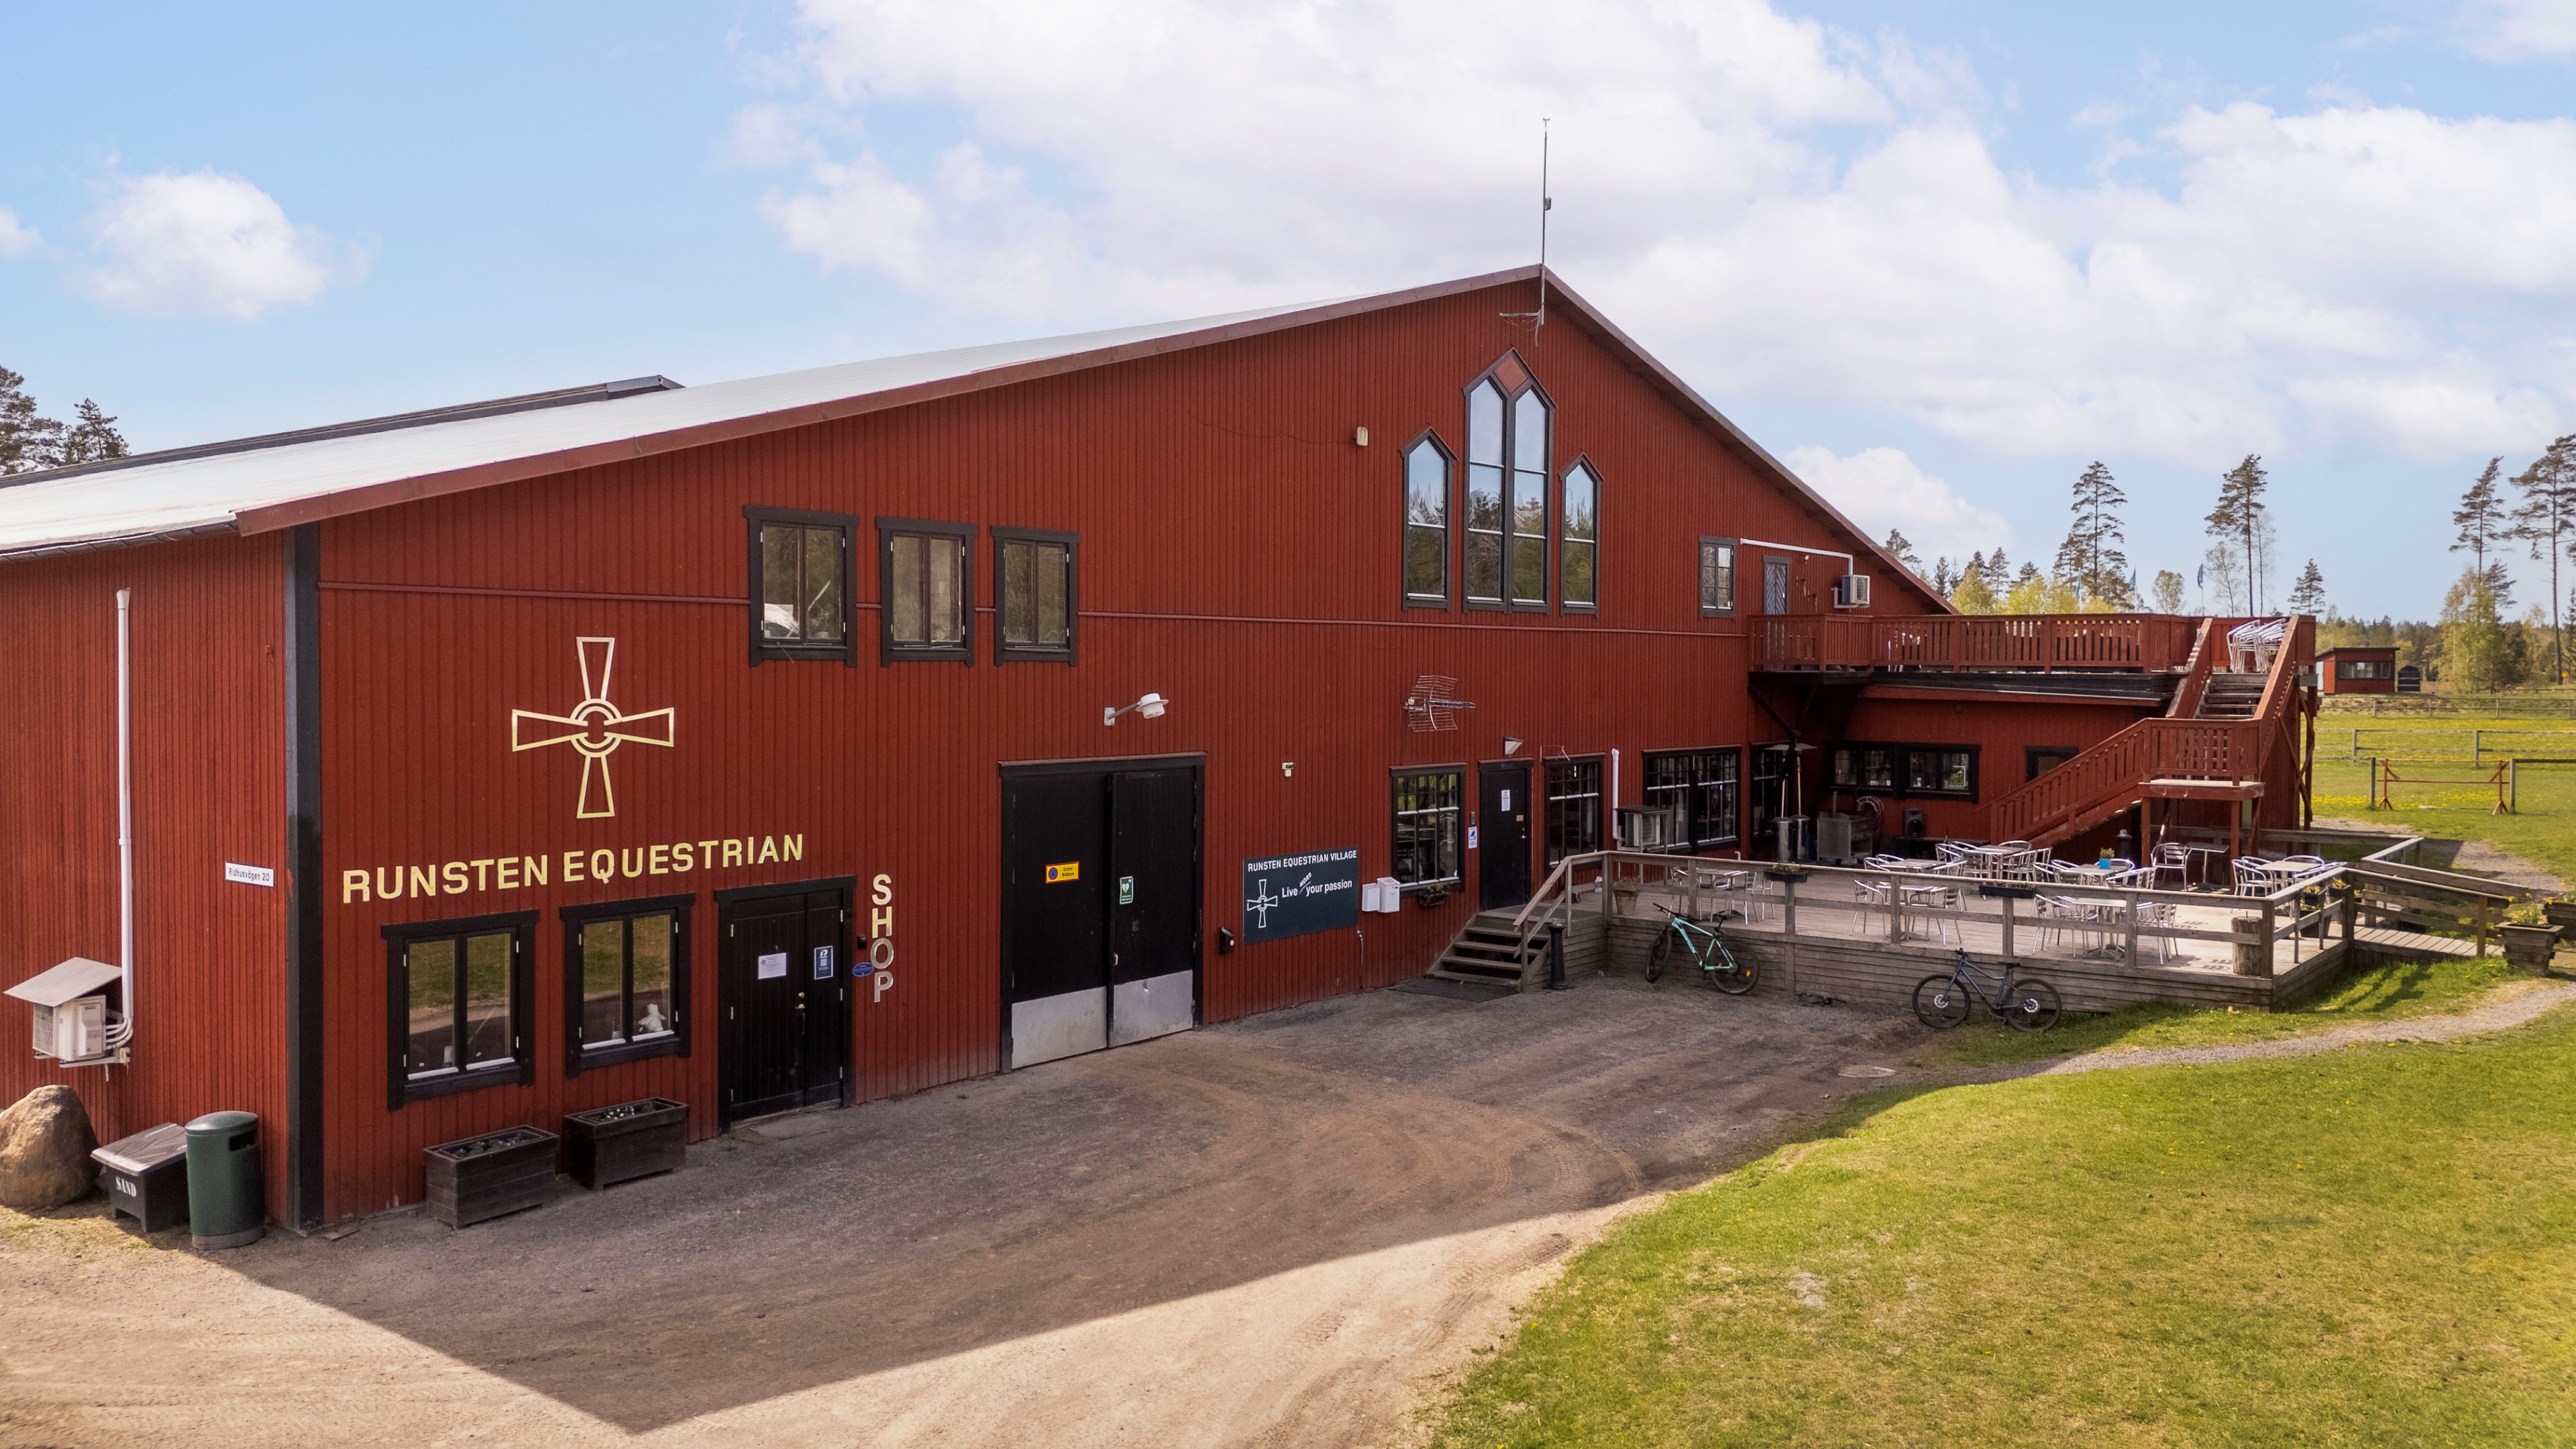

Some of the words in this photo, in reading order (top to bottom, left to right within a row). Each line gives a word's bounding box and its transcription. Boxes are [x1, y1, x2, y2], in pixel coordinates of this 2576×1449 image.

[343, 855, 548, 904] RUNSTEN
[564, 834, 803, 884] EQUESTRIAN
[1248, 859, 1281, 872] RUNSTEN
[1283, 853, 1329, 868] EQUESTRIAN
[1330, 850, 1357, 861] VILLAGE
[229, 867, 261, 881] Ridhusvägen
[262, 873, 270, 881] 20
[1282, 887, 1298, 898] Live
[1306, 884, 1324, 897] your
[1325, 879, 1352, 894] passion
[870, 873, 894, 1003] SHOP
[116, 1176, 137, 1197] SAND
